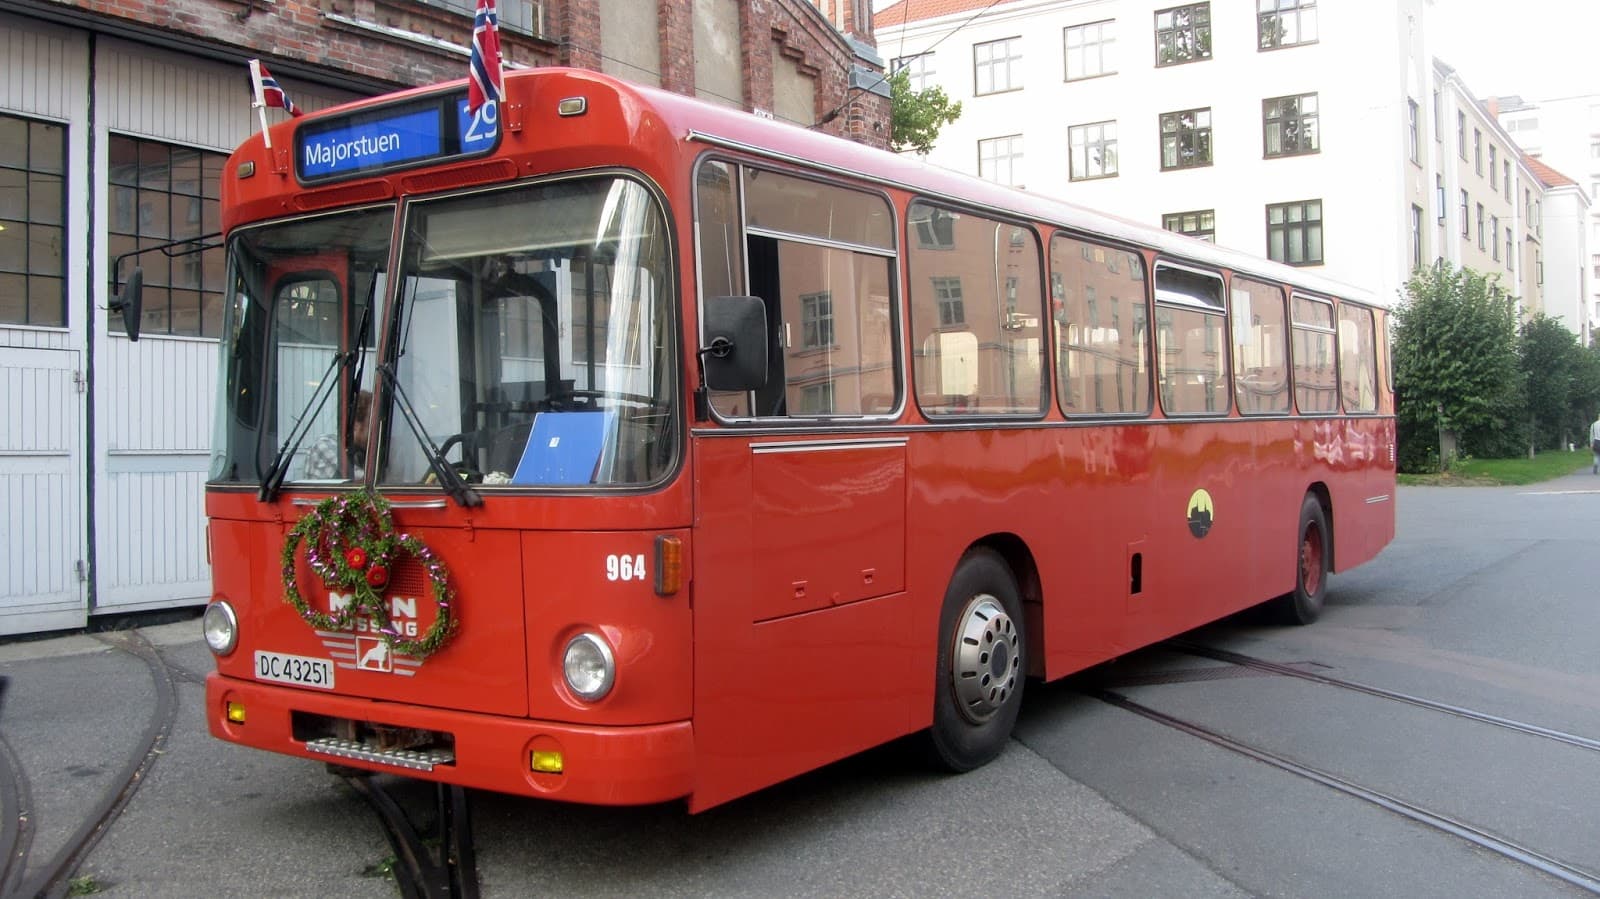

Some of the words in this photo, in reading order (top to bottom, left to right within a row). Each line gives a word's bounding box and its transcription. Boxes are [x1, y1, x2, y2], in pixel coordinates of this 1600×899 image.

[463, 100, 497, 142] 29
[305, 133, 399, 167] Majorstuen
[606, 554, 646, 581] 964
[329, 592, 417, 618] MN
